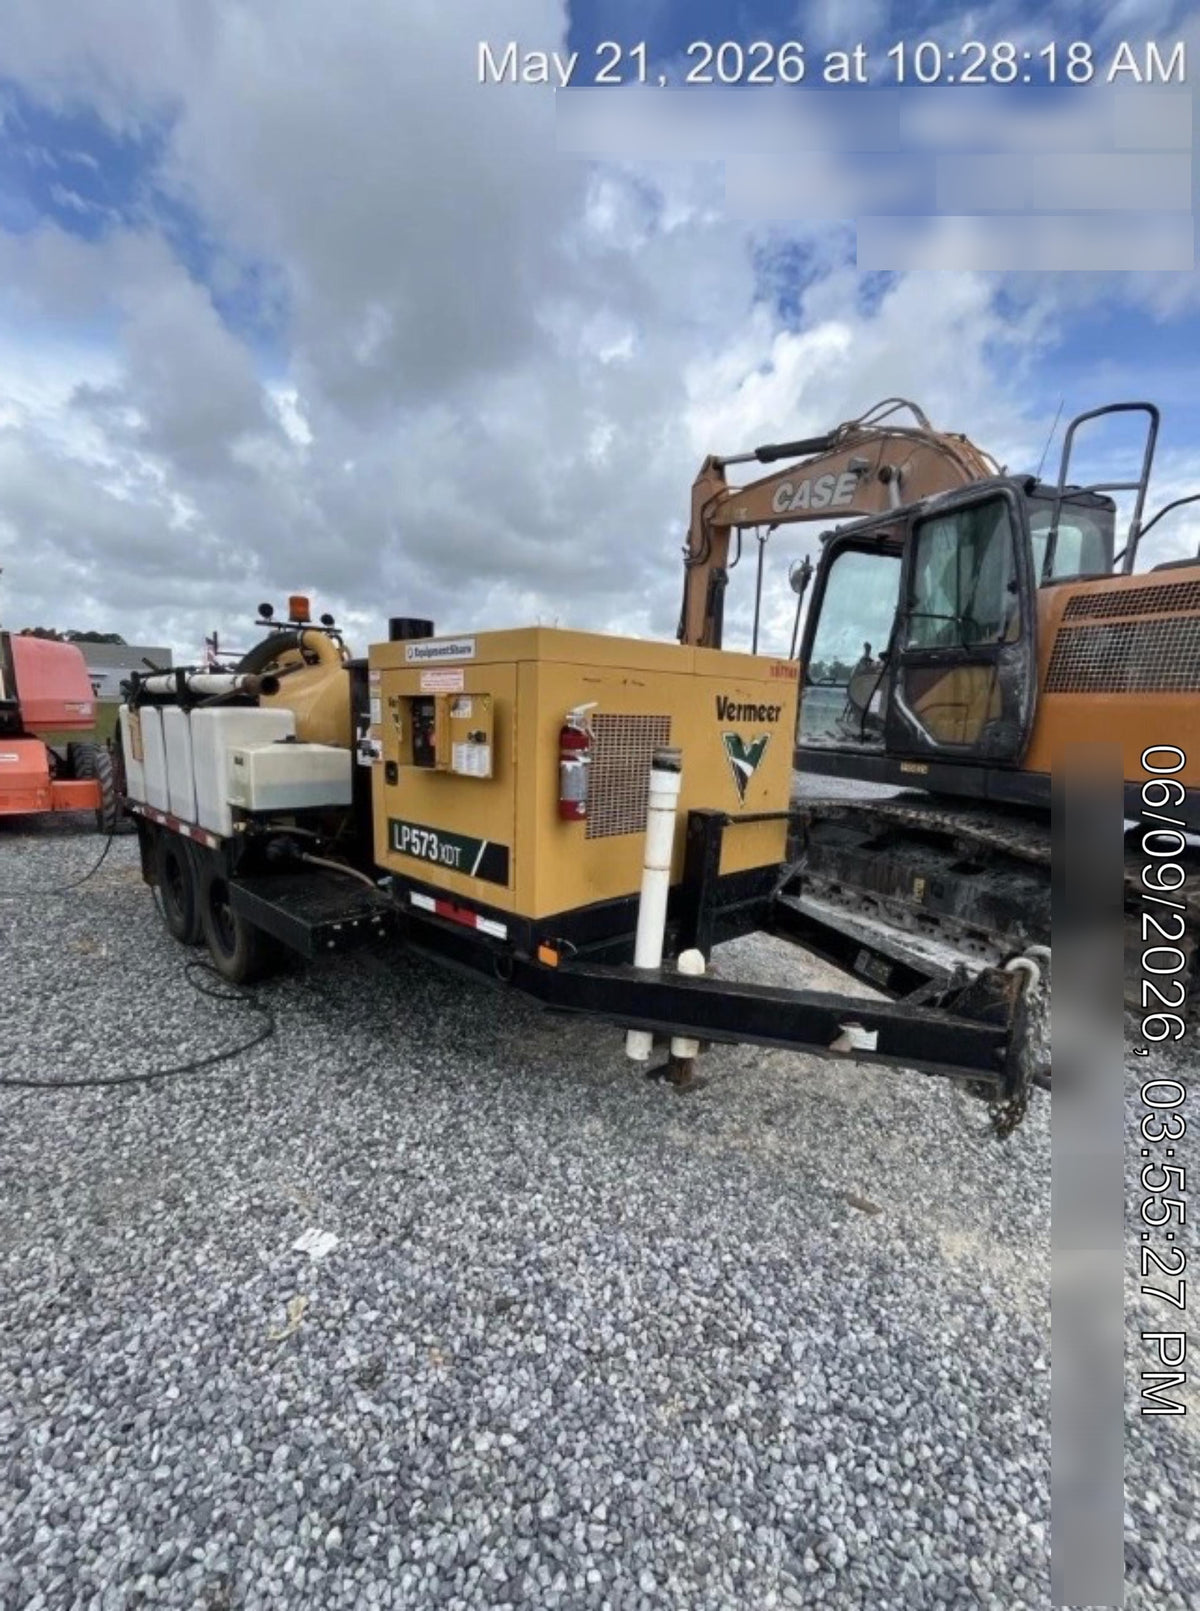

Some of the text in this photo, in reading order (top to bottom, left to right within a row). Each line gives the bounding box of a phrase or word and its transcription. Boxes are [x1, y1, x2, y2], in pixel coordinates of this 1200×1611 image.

[772, 472, 858, 513] CASE
[716, 695, 782, 722] Vermeer
[393, 823, 439, 861] LP573
